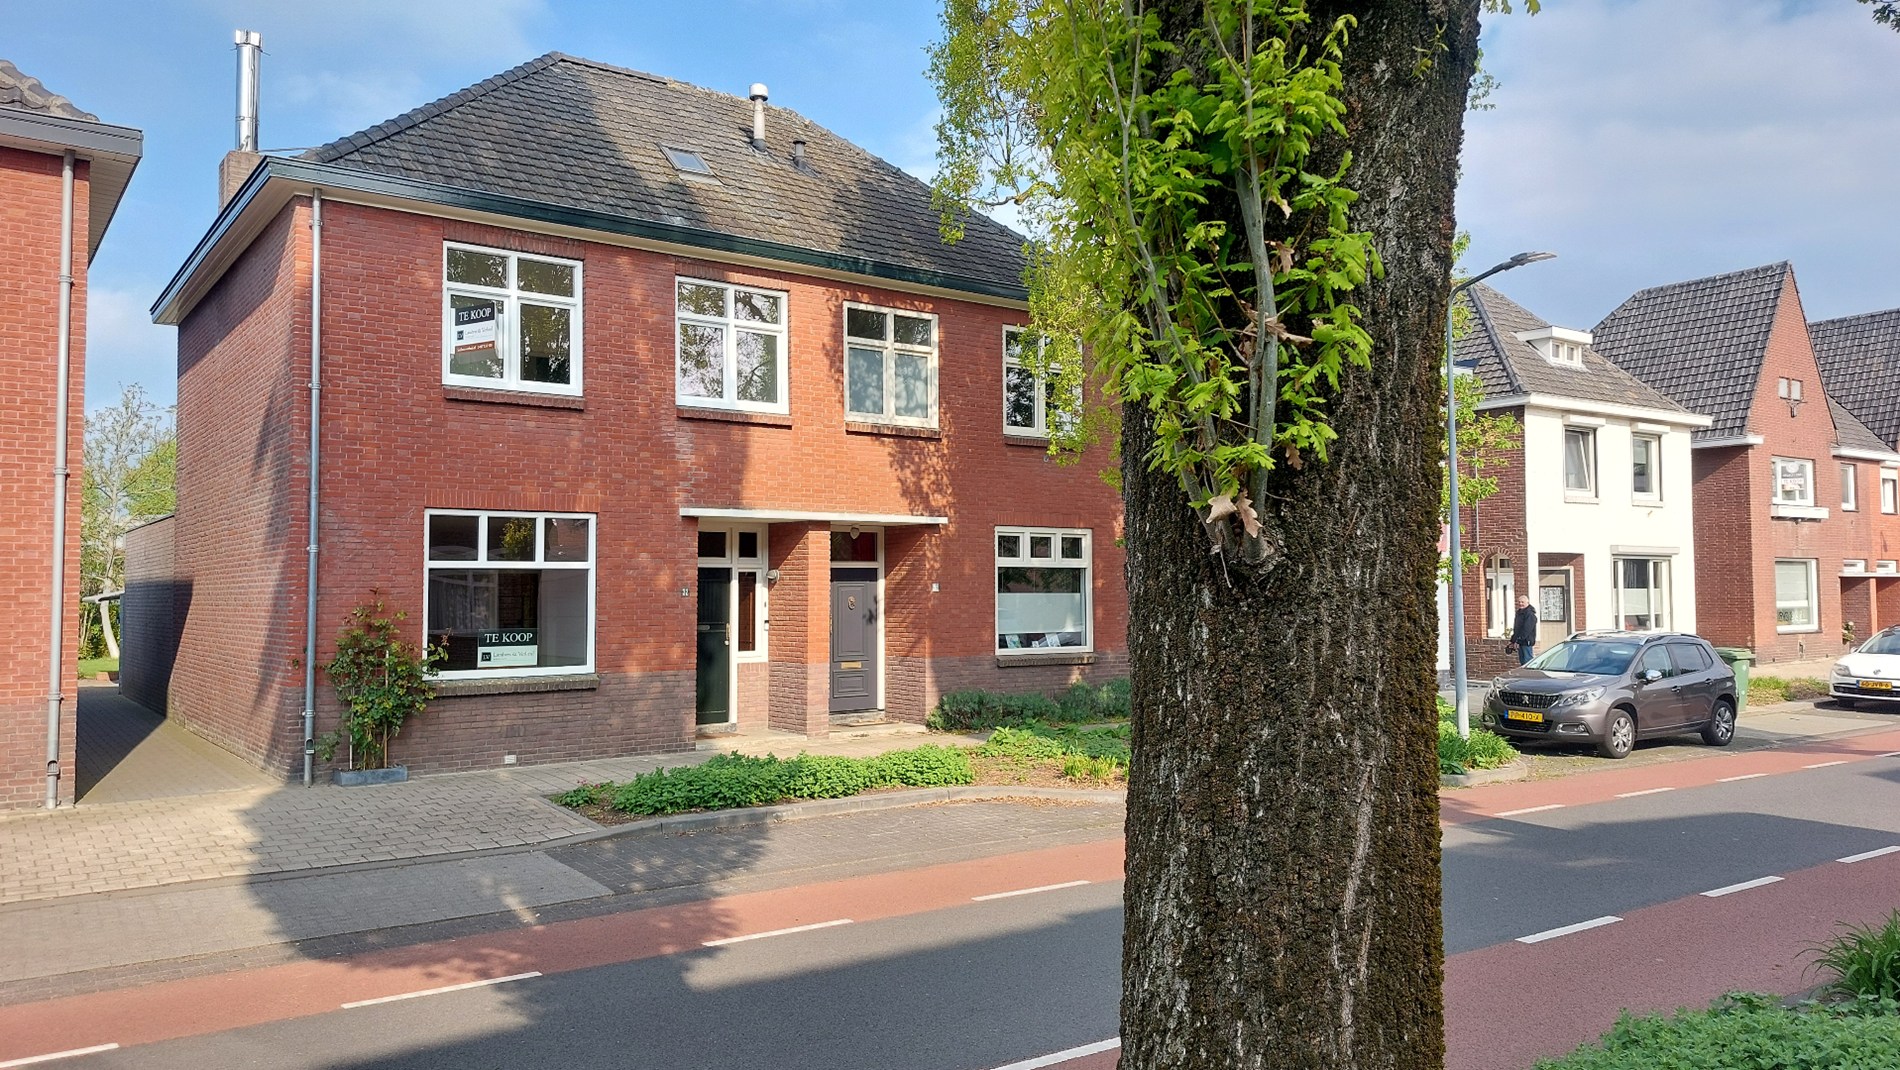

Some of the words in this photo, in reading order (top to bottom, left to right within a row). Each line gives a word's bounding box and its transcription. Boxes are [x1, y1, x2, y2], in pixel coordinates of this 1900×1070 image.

[459, 311, 469, 322] TE
[470, 307, 491, 320] KOOP
[484, 633, 500, 643] TE
[501, 632, 533, 643] KOOP
